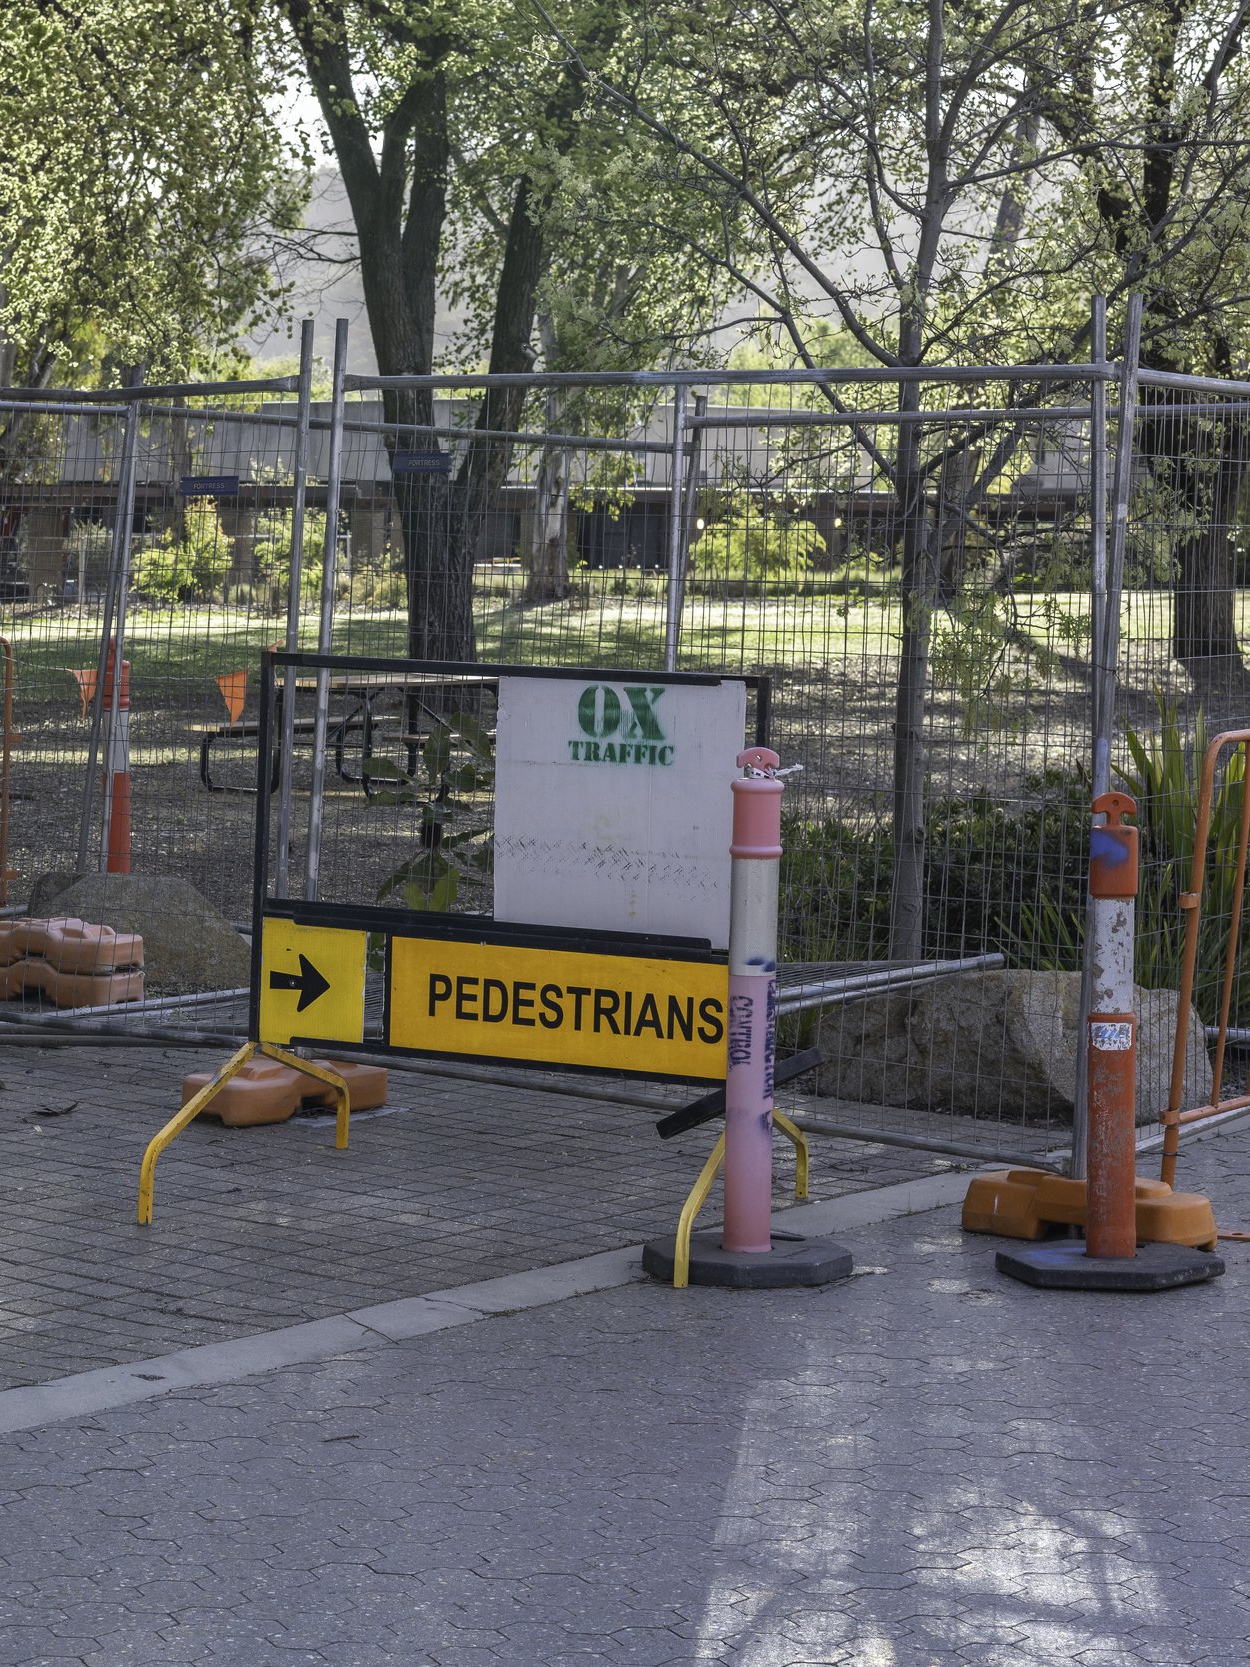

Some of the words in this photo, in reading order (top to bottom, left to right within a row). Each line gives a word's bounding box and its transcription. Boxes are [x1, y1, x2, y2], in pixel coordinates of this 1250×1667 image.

[408, 459, 441, 467] FORTRESS
[193, 482, 226, 490] FORTRESS
[577, 685, 666, 741] OX
[568, 740, 674, 766] TRAFFIC
[428, 973, 725, 1044] PEDESTRIANS
